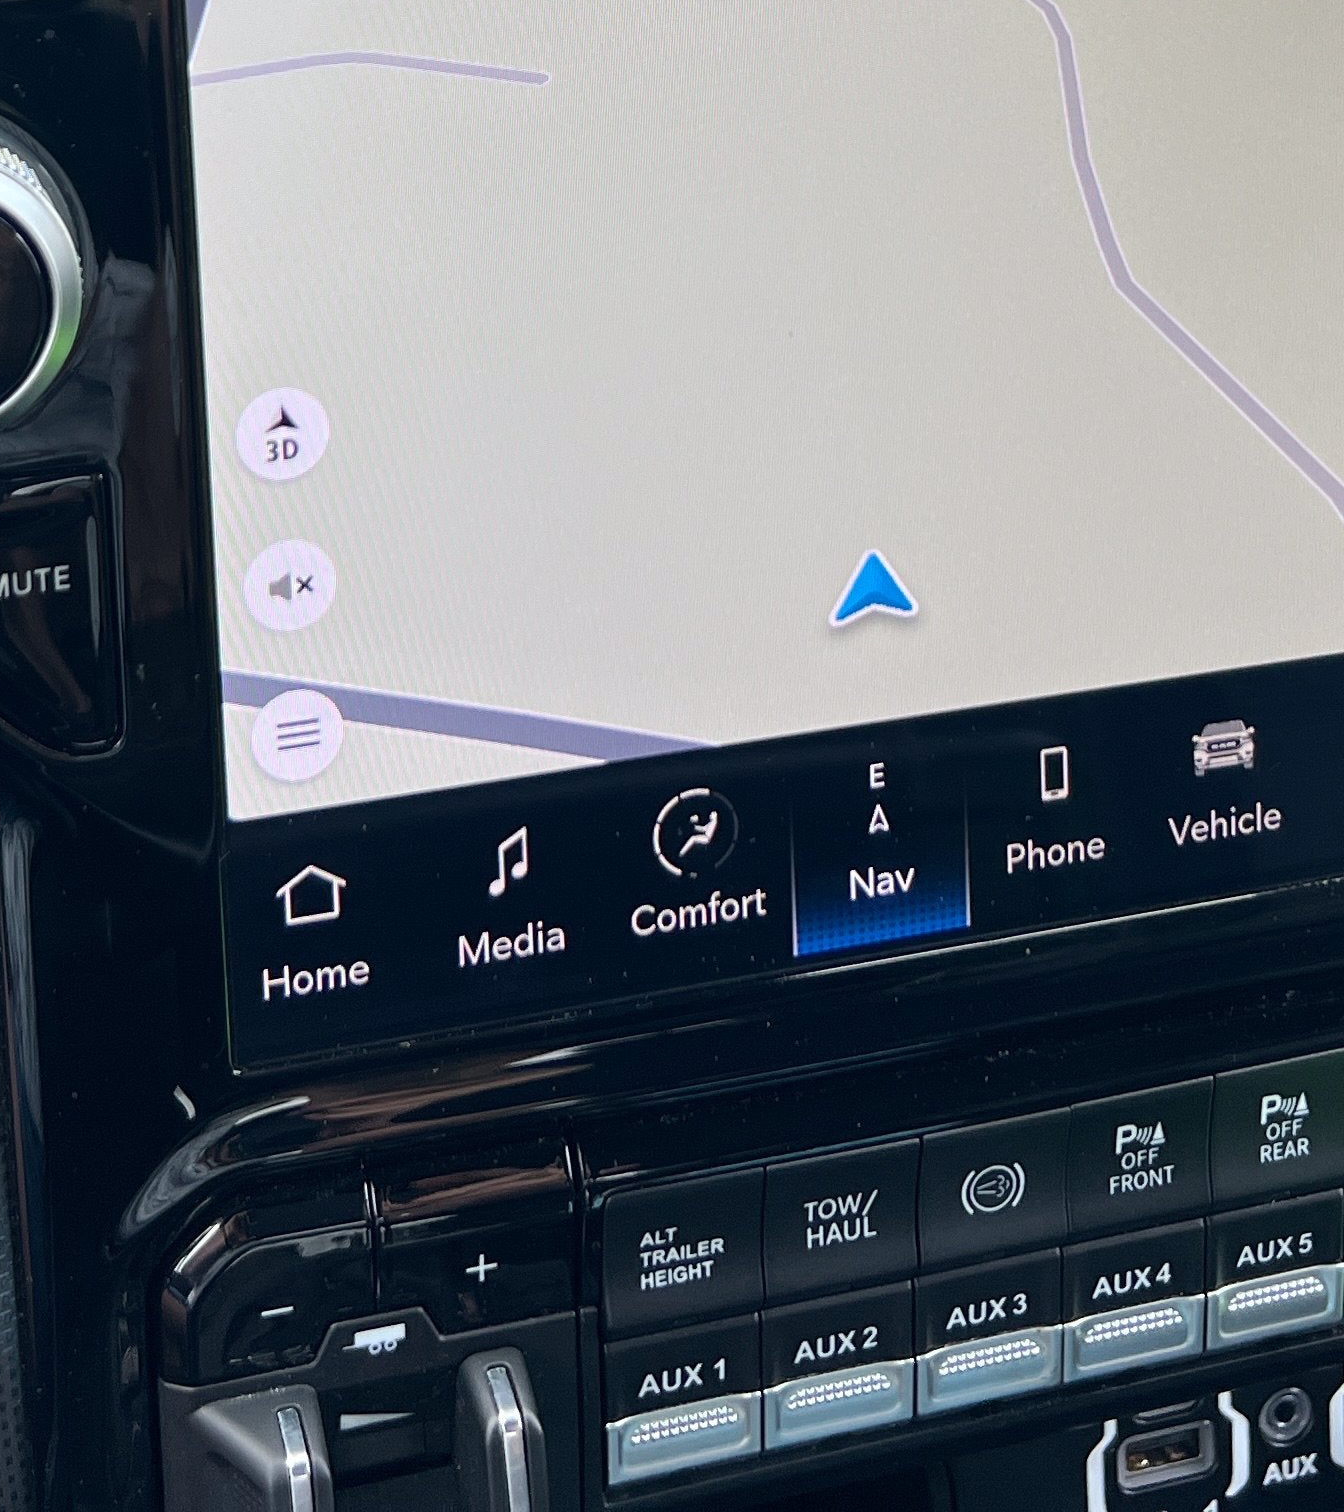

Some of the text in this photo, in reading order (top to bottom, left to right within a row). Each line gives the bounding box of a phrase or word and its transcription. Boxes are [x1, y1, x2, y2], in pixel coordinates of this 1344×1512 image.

[264, 439, 299, 463] 3D
[869, 761, 886, 789] E
[1168, 802, 1282, 846] Vehicle
[1006, 835, 1106, 874] Phone
[848, 866, 916, 901] Nav
[630, 887, 768, 938] Comfort
[457, 920, 567, 968] Media
[261, 957, 371, 1001] Home
[1265, 1121, 1304, 1141] OFF
[1120, 1149, 1159, 1170] OFF
[1259, 1138, 1309, 1162] REAR
[1109, 1163, 1175, 1194] FRONT
[804, 1188, 878, 1223] TOW/
[639, 1226, 677, 1248] ALT
[806, 1215, 877, 1249] HAUL
[639, 1237, 725, 1268] TRAILER
[1236, 1232, 1314, 1268] AUX 5
[640, 1261, 714, 1289] HEIGHT
[1092, 1261, 1172, 1299] AUX 4
[945, 1292, 1028, 1329] AUX 3
[793, 1325, 879, 1364] AUX 2
[638, 1358, 727, 1398] AUX 1
[1262, 1453, 1317, 1485] AUX
